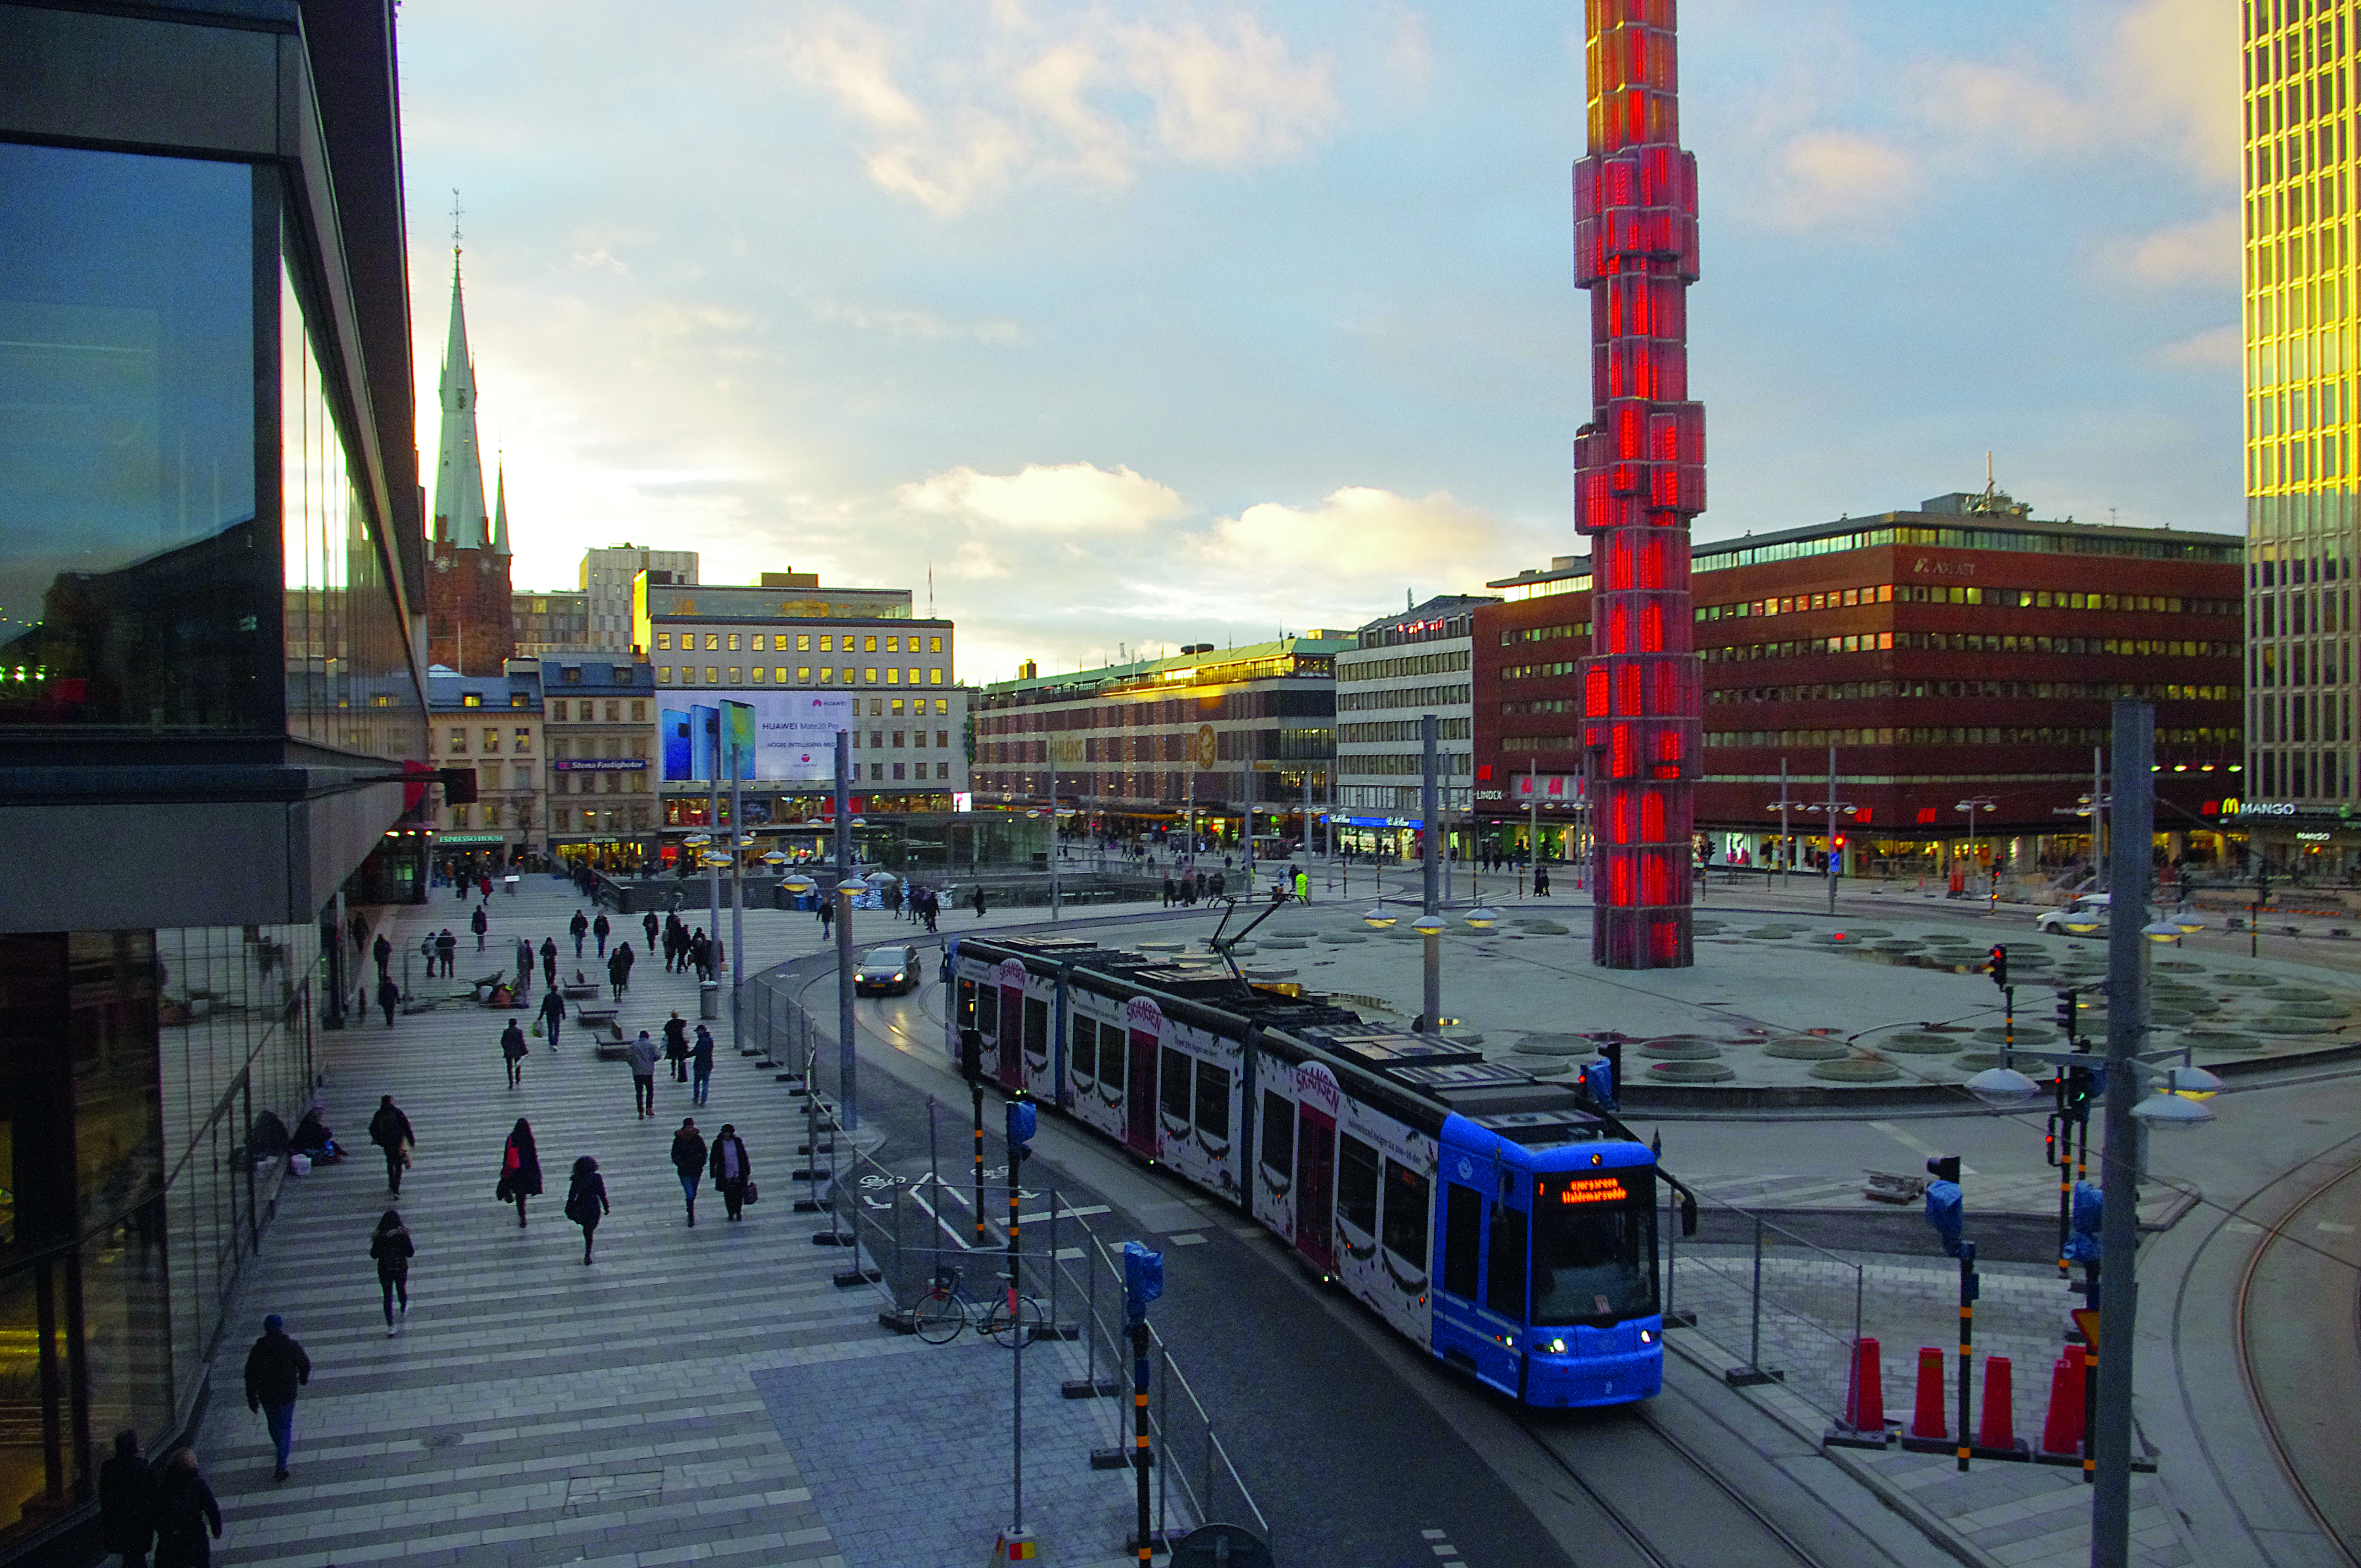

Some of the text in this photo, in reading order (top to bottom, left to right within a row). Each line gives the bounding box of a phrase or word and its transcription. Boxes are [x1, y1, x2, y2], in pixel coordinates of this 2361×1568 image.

[1476, 790, 1503, 800] LINDEX
[2240, 802, 2296, 815] MANGO
[2297, 832, 2331, 841] MANGO
[1127, 1000, 1161, 1034] SKANSEN
[1296, 1067, 1340, 1114] SKANSEN
